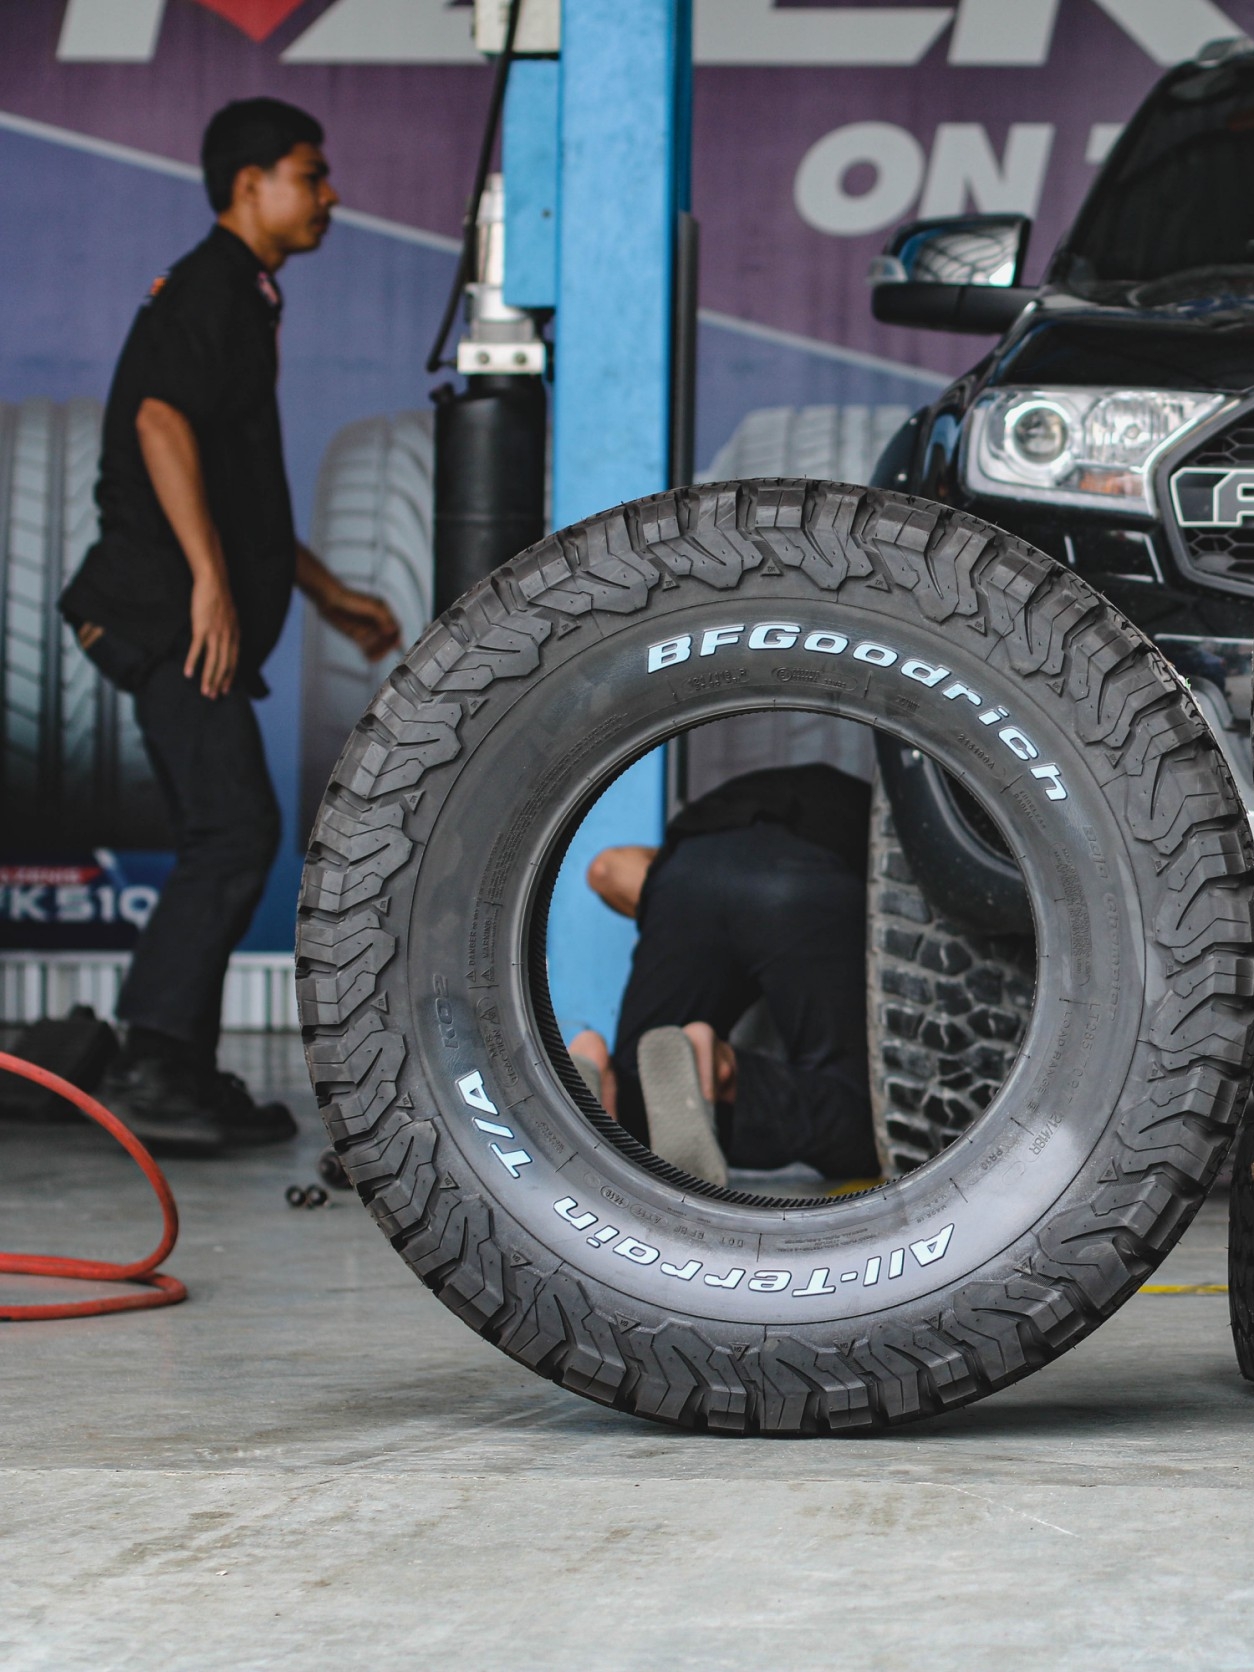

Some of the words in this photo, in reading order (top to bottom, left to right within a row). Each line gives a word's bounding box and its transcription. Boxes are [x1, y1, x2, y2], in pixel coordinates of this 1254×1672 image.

[793, 121, 1054, 237] ON
[644, 618, 1071, 803] BFGoodrich
[455, 1070, 535, 1178] T/A
[557, 1197, 958, 1302] All-Terrain
